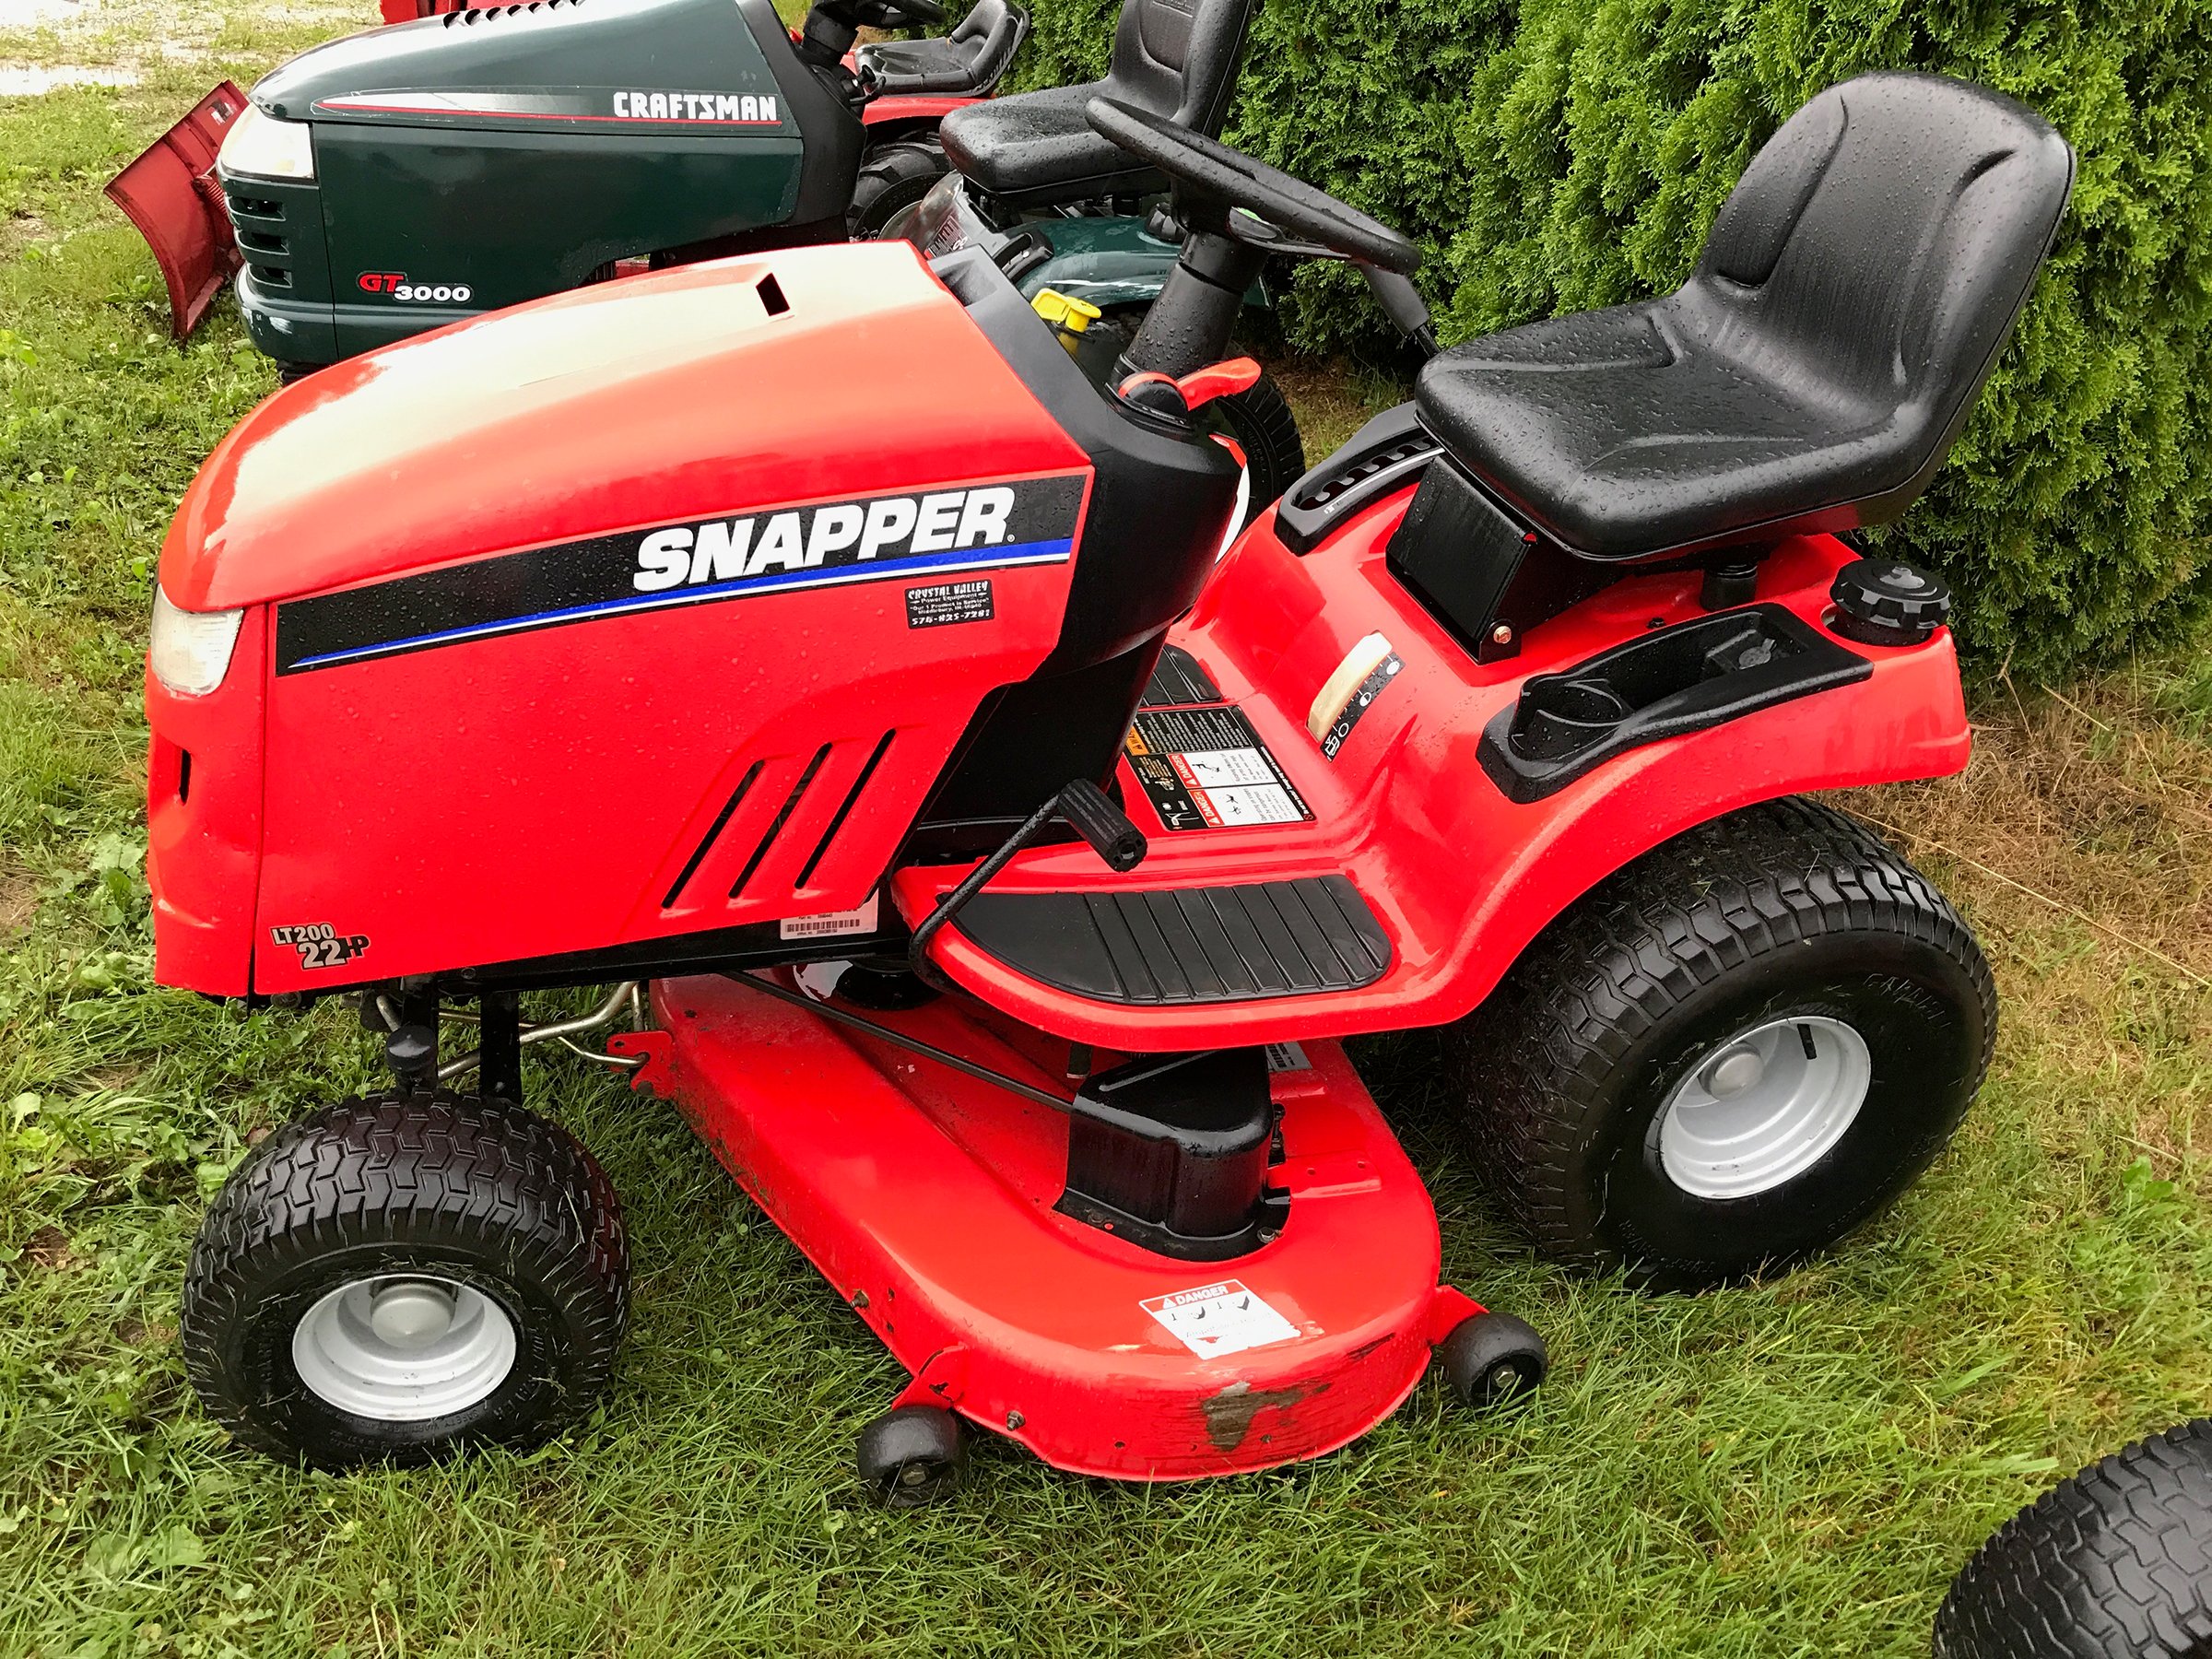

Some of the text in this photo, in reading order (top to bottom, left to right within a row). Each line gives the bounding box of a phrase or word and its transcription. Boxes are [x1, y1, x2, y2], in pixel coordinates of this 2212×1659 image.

[613, 92, 777, 121] CRAFTSMAN
[633, 487, 1015, 592] SNAPPER
[908, 581, 988, 599] CRYSTAL VALLEY
[943, 593, 977, 601] Equipment
[1171, 755, 1192, 778] DANGER
[1193, 791, 1215, 816] DANGER
[271, 924, 335, 945] LT200
[1176, 1286, 1229, 1306] DANGER
